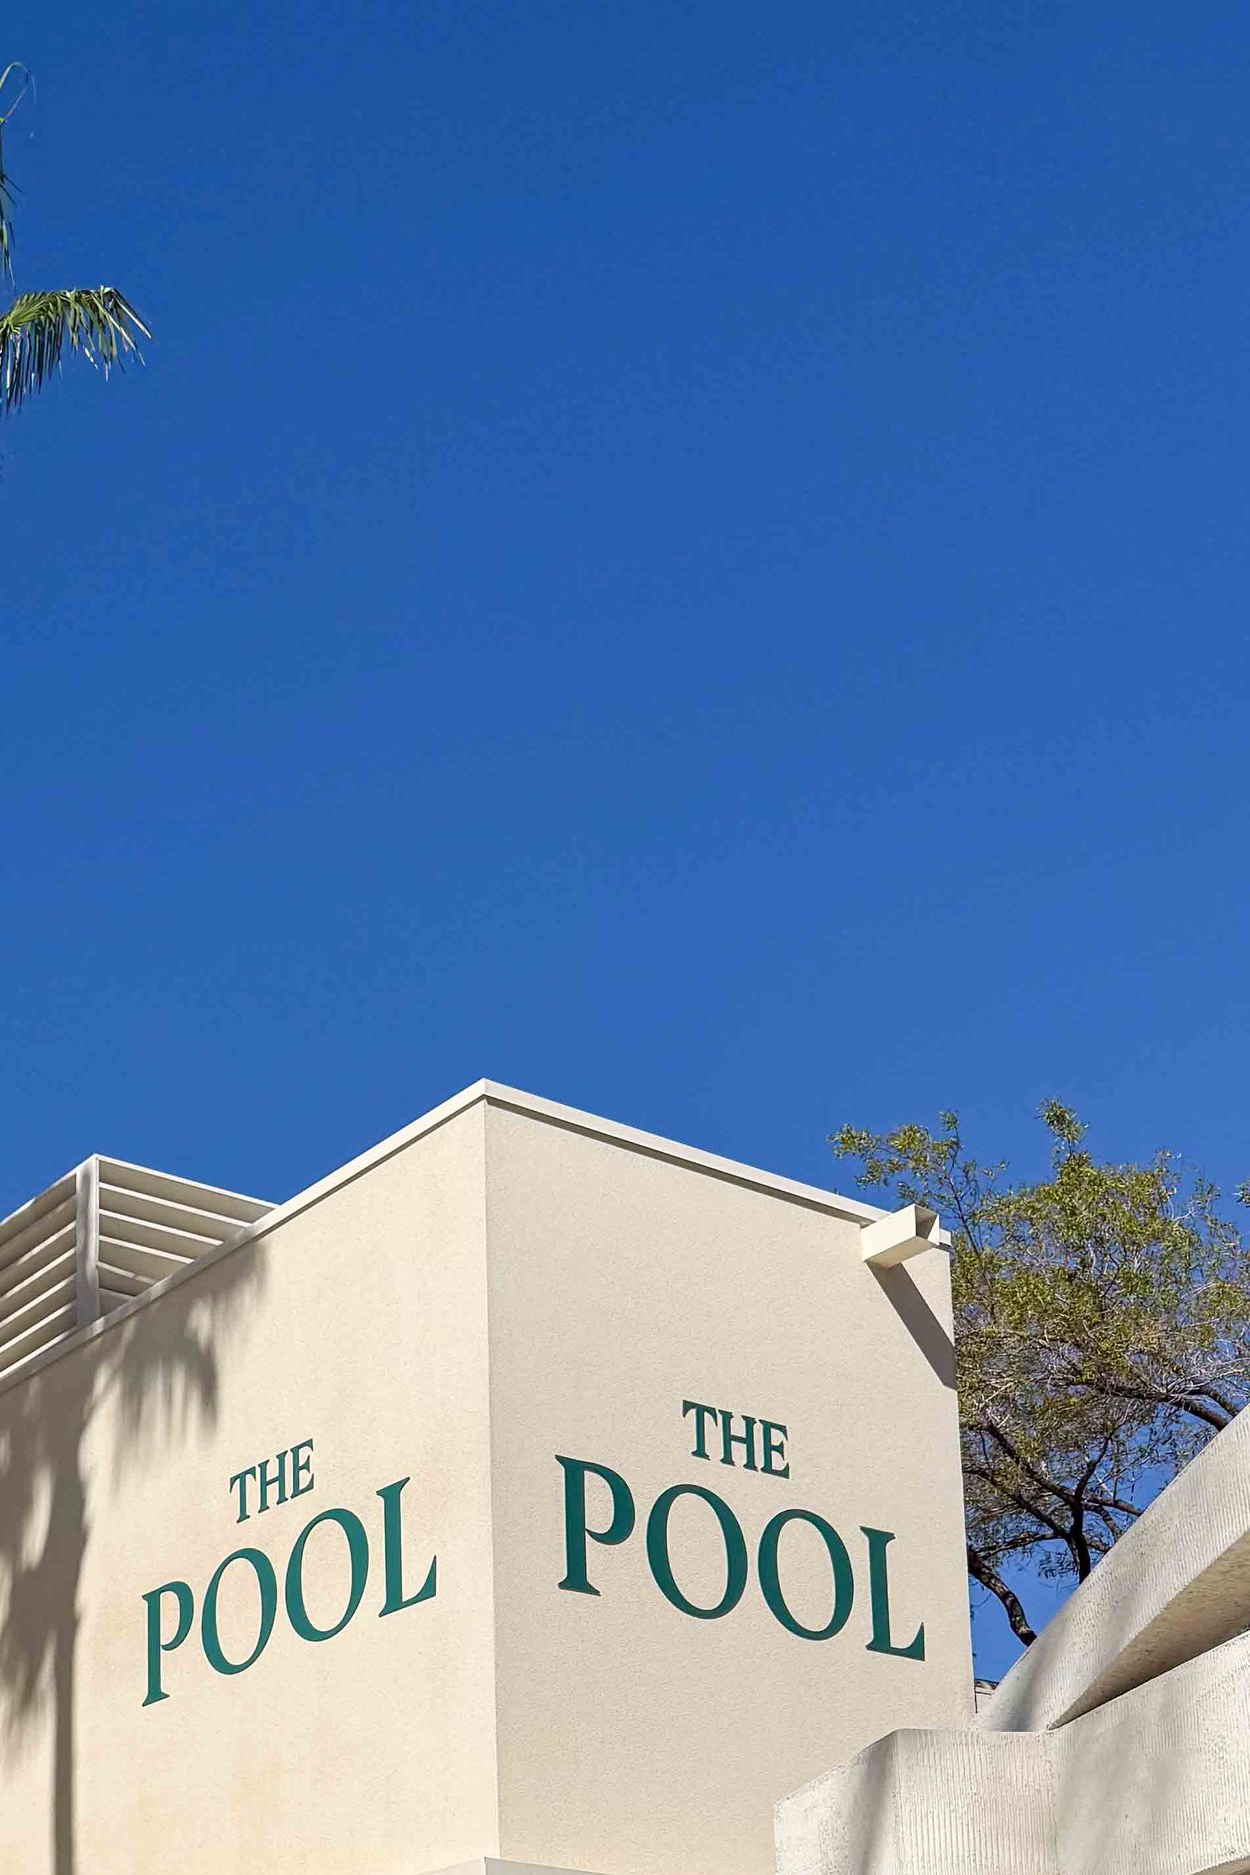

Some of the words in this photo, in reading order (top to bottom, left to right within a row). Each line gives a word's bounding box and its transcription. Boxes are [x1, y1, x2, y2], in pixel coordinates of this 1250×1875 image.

[229, 1437, 314, 1524] THE
[681, 1399, 790, 1479] THE
[141, 1475, 438, 1709] POOL
[554, 1453, 926, 1662] POOL
